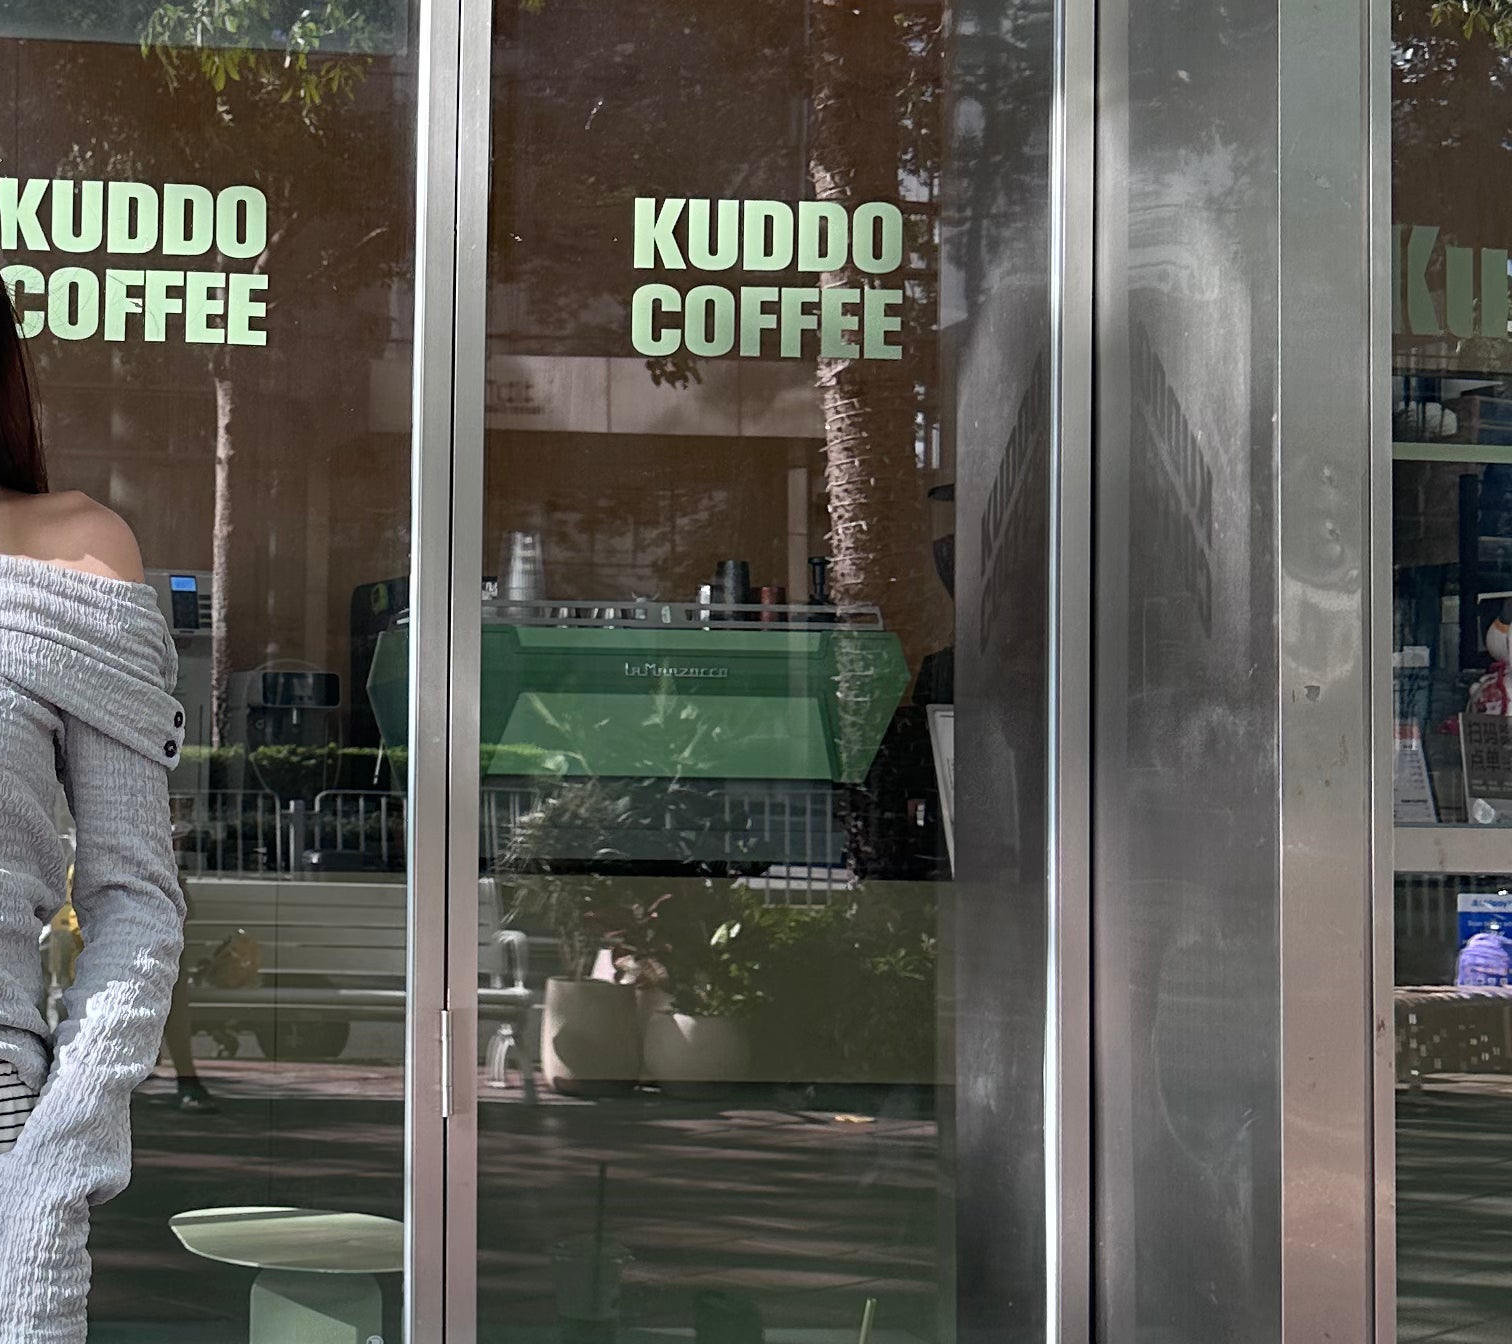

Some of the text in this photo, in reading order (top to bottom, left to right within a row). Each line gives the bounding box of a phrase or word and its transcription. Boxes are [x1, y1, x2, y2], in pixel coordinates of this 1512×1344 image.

[633, 198, 903, 274] KUDDO
[2, 265, 268, 346] COFFEE
[631, 284, 903, 359] COFFEE
